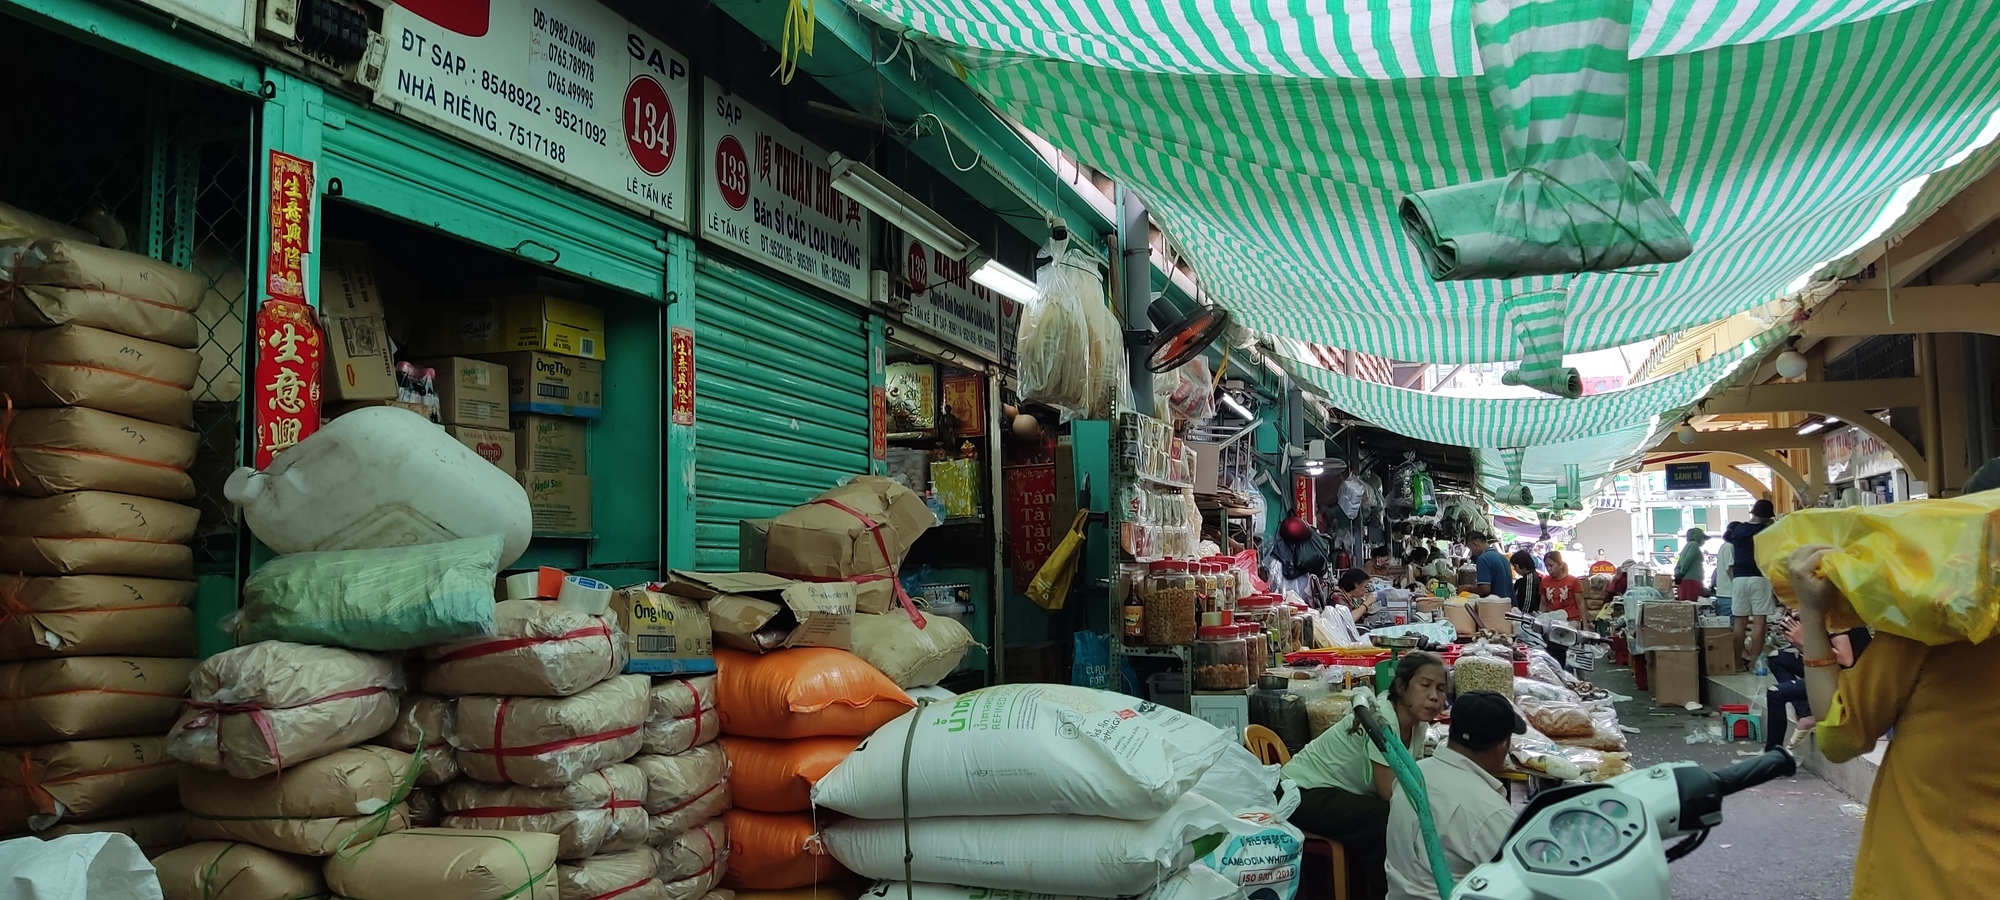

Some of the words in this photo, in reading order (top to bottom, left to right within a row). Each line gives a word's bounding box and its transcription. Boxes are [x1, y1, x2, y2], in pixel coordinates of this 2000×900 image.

[549, 17, 596, 59] 0982.676840
[627, 33, 686, 81] SẠP
[402, 28, 426, 58] ĐT
[431, 44, 466, 77] SẠP
[481, 71, 541, 116] 8548922
[555, 109, 607, 147] 9521092
[397, 68, 437, 107] NHÀ
[508, 120, 566, 164] 7517188
[631, 96, 670, 158] 134
[716, 96, 742, 127] SẠP
[721, 151, 746, 196] 133
[754, 131, 772, 188] 順
[626, 176, 640, 194] LÊ
[641, 179, 659, 205] TẤN
[708, 212, 719, 232] LÊ
[720, 217, 737, 239] TẤN
[753, 197, 773, 229] Bán
[786, 210, 806, 246] CÁC
[808, 229, 829, 261] LOẠI
[831, 232, 861, 271] ĐƯỜNG
[910, 252, 927, 286] 132
[991, 697, 1007, 730] REFINED
[1221, 855, 1265, 867] CAMBODIA
[1242, 873, 1256, 883] ISO
